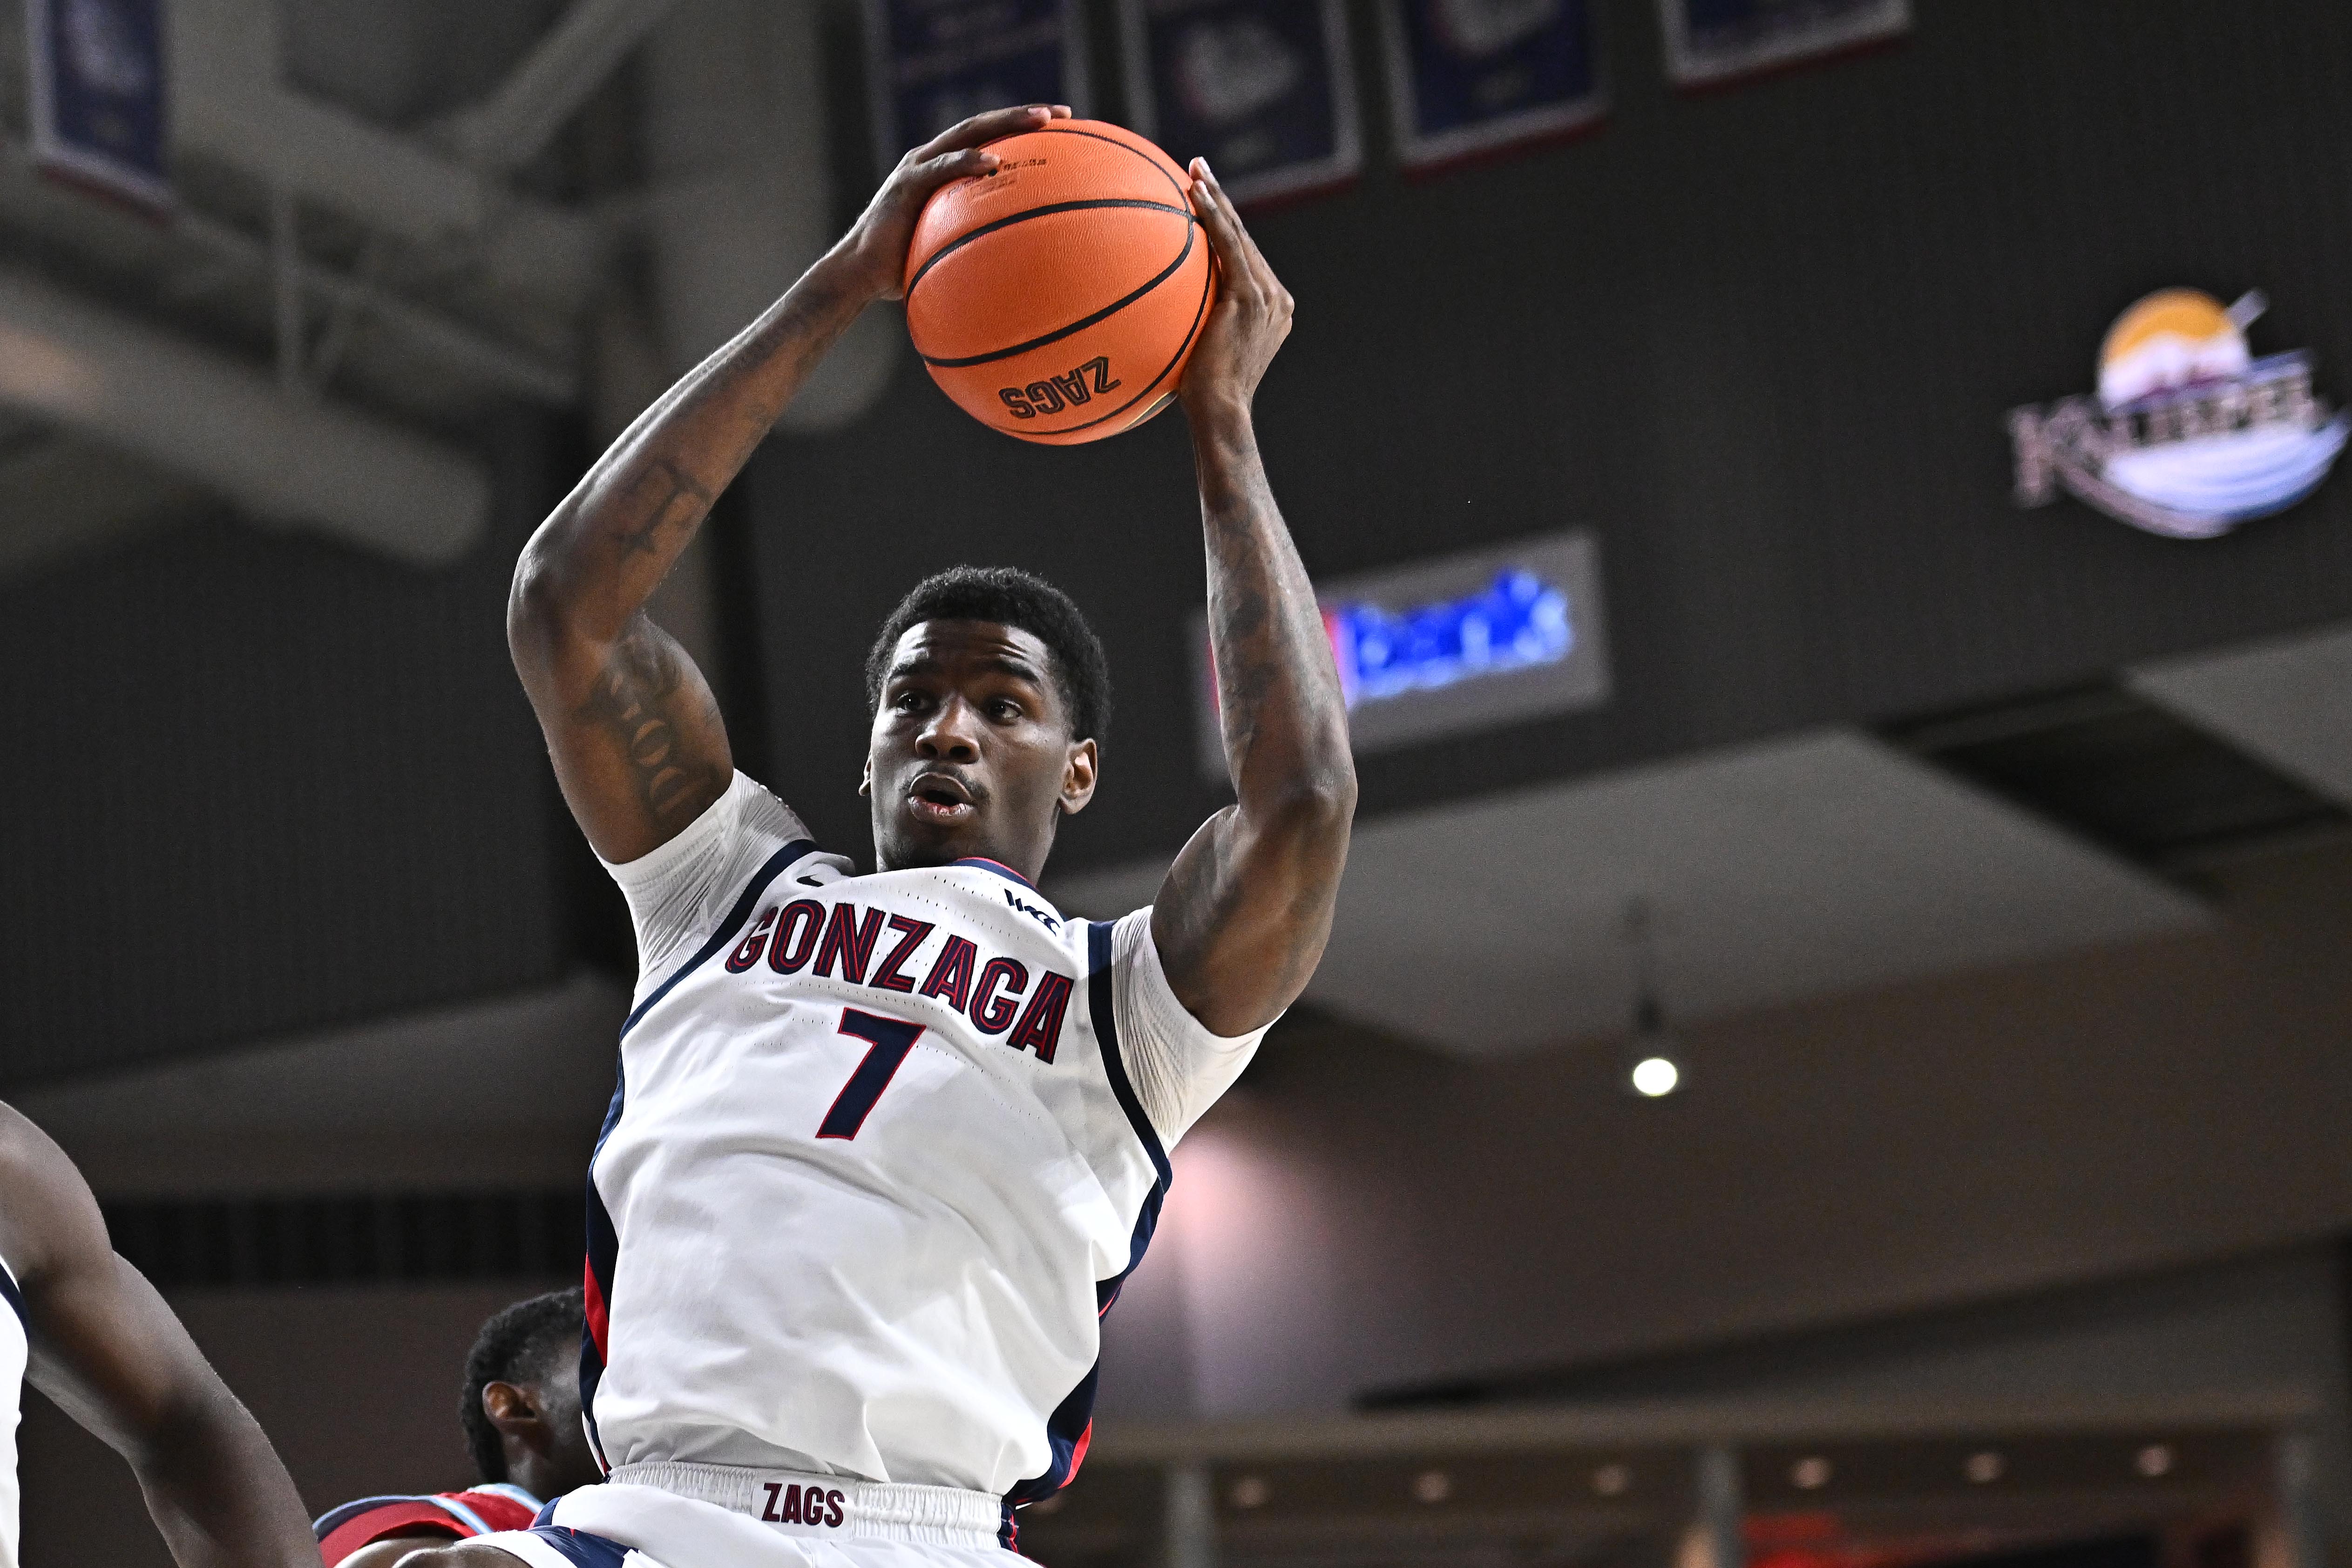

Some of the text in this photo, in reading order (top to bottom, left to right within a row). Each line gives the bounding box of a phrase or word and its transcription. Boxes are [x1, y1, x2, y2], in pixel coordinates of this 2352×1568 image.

[998, 355, 1121, 419] ZAGS
[724, 898, 1075, 1065] GONZAGA
[815, 1007, 927, 1141] 7
[761, 1482, 846, 1528] ZAGS
